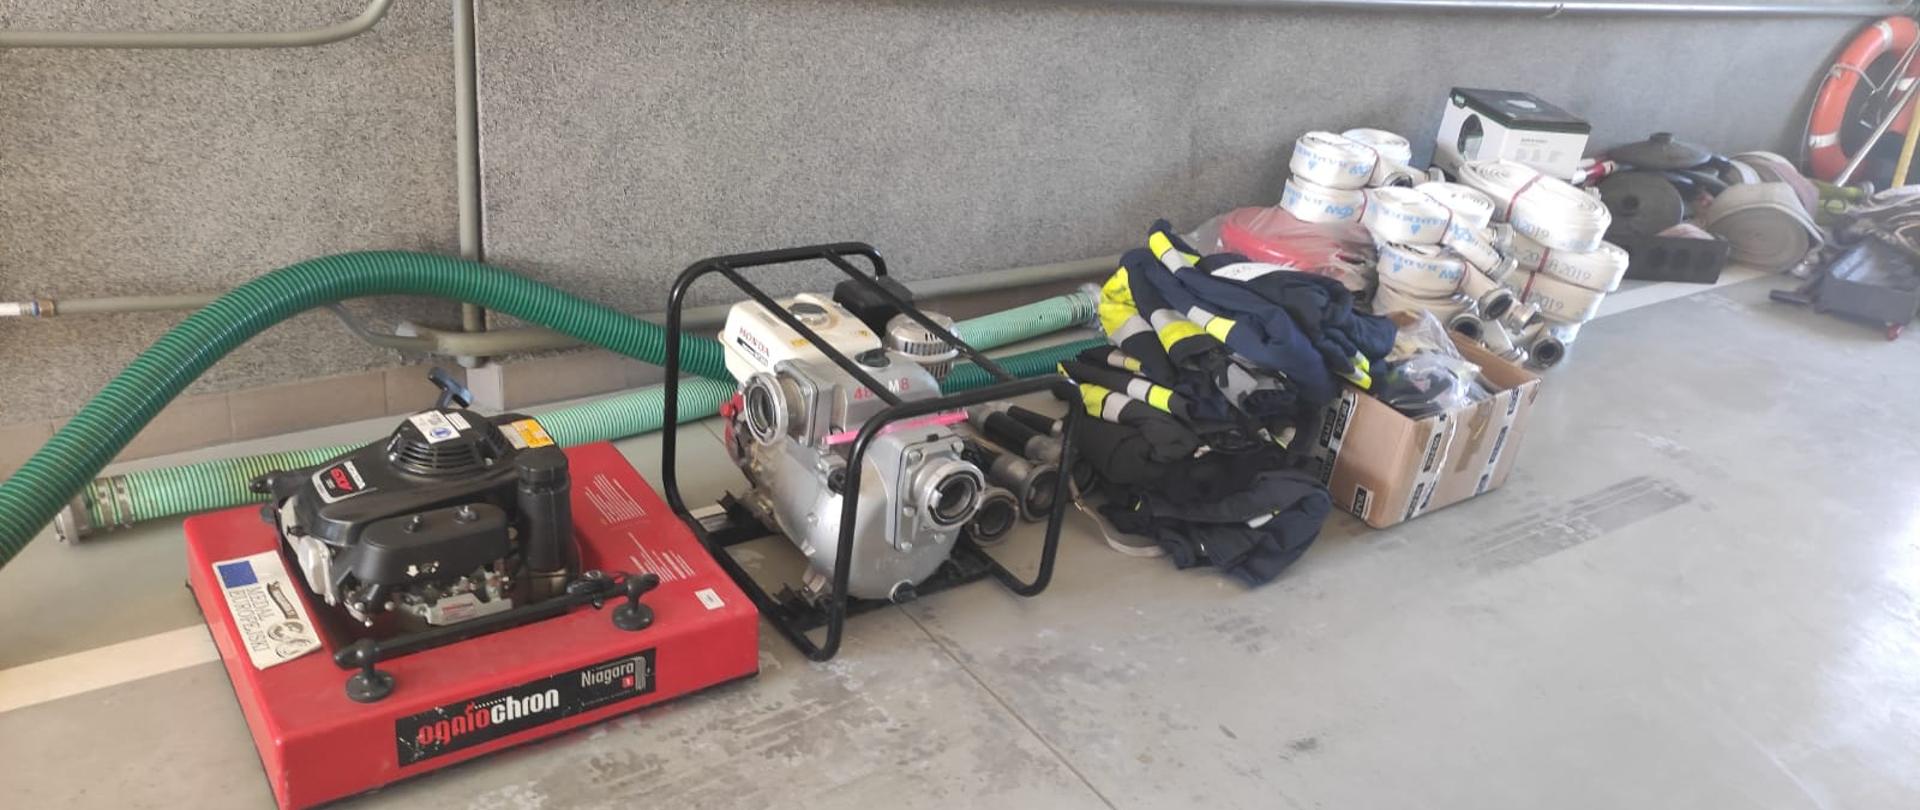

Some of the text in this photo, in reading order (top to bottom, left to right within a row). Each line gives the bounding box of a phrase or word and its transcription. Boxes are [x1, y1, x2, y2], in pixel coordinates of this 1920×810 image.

[740, 326, 770, 358] HONDA
[229, 586, 271, 653] EUROPEJSKI
[246, 585, 276, 621] MEDAL
[581, 662, 635, 688] Niagara
[418, 687, 560, 747] ogniochron
